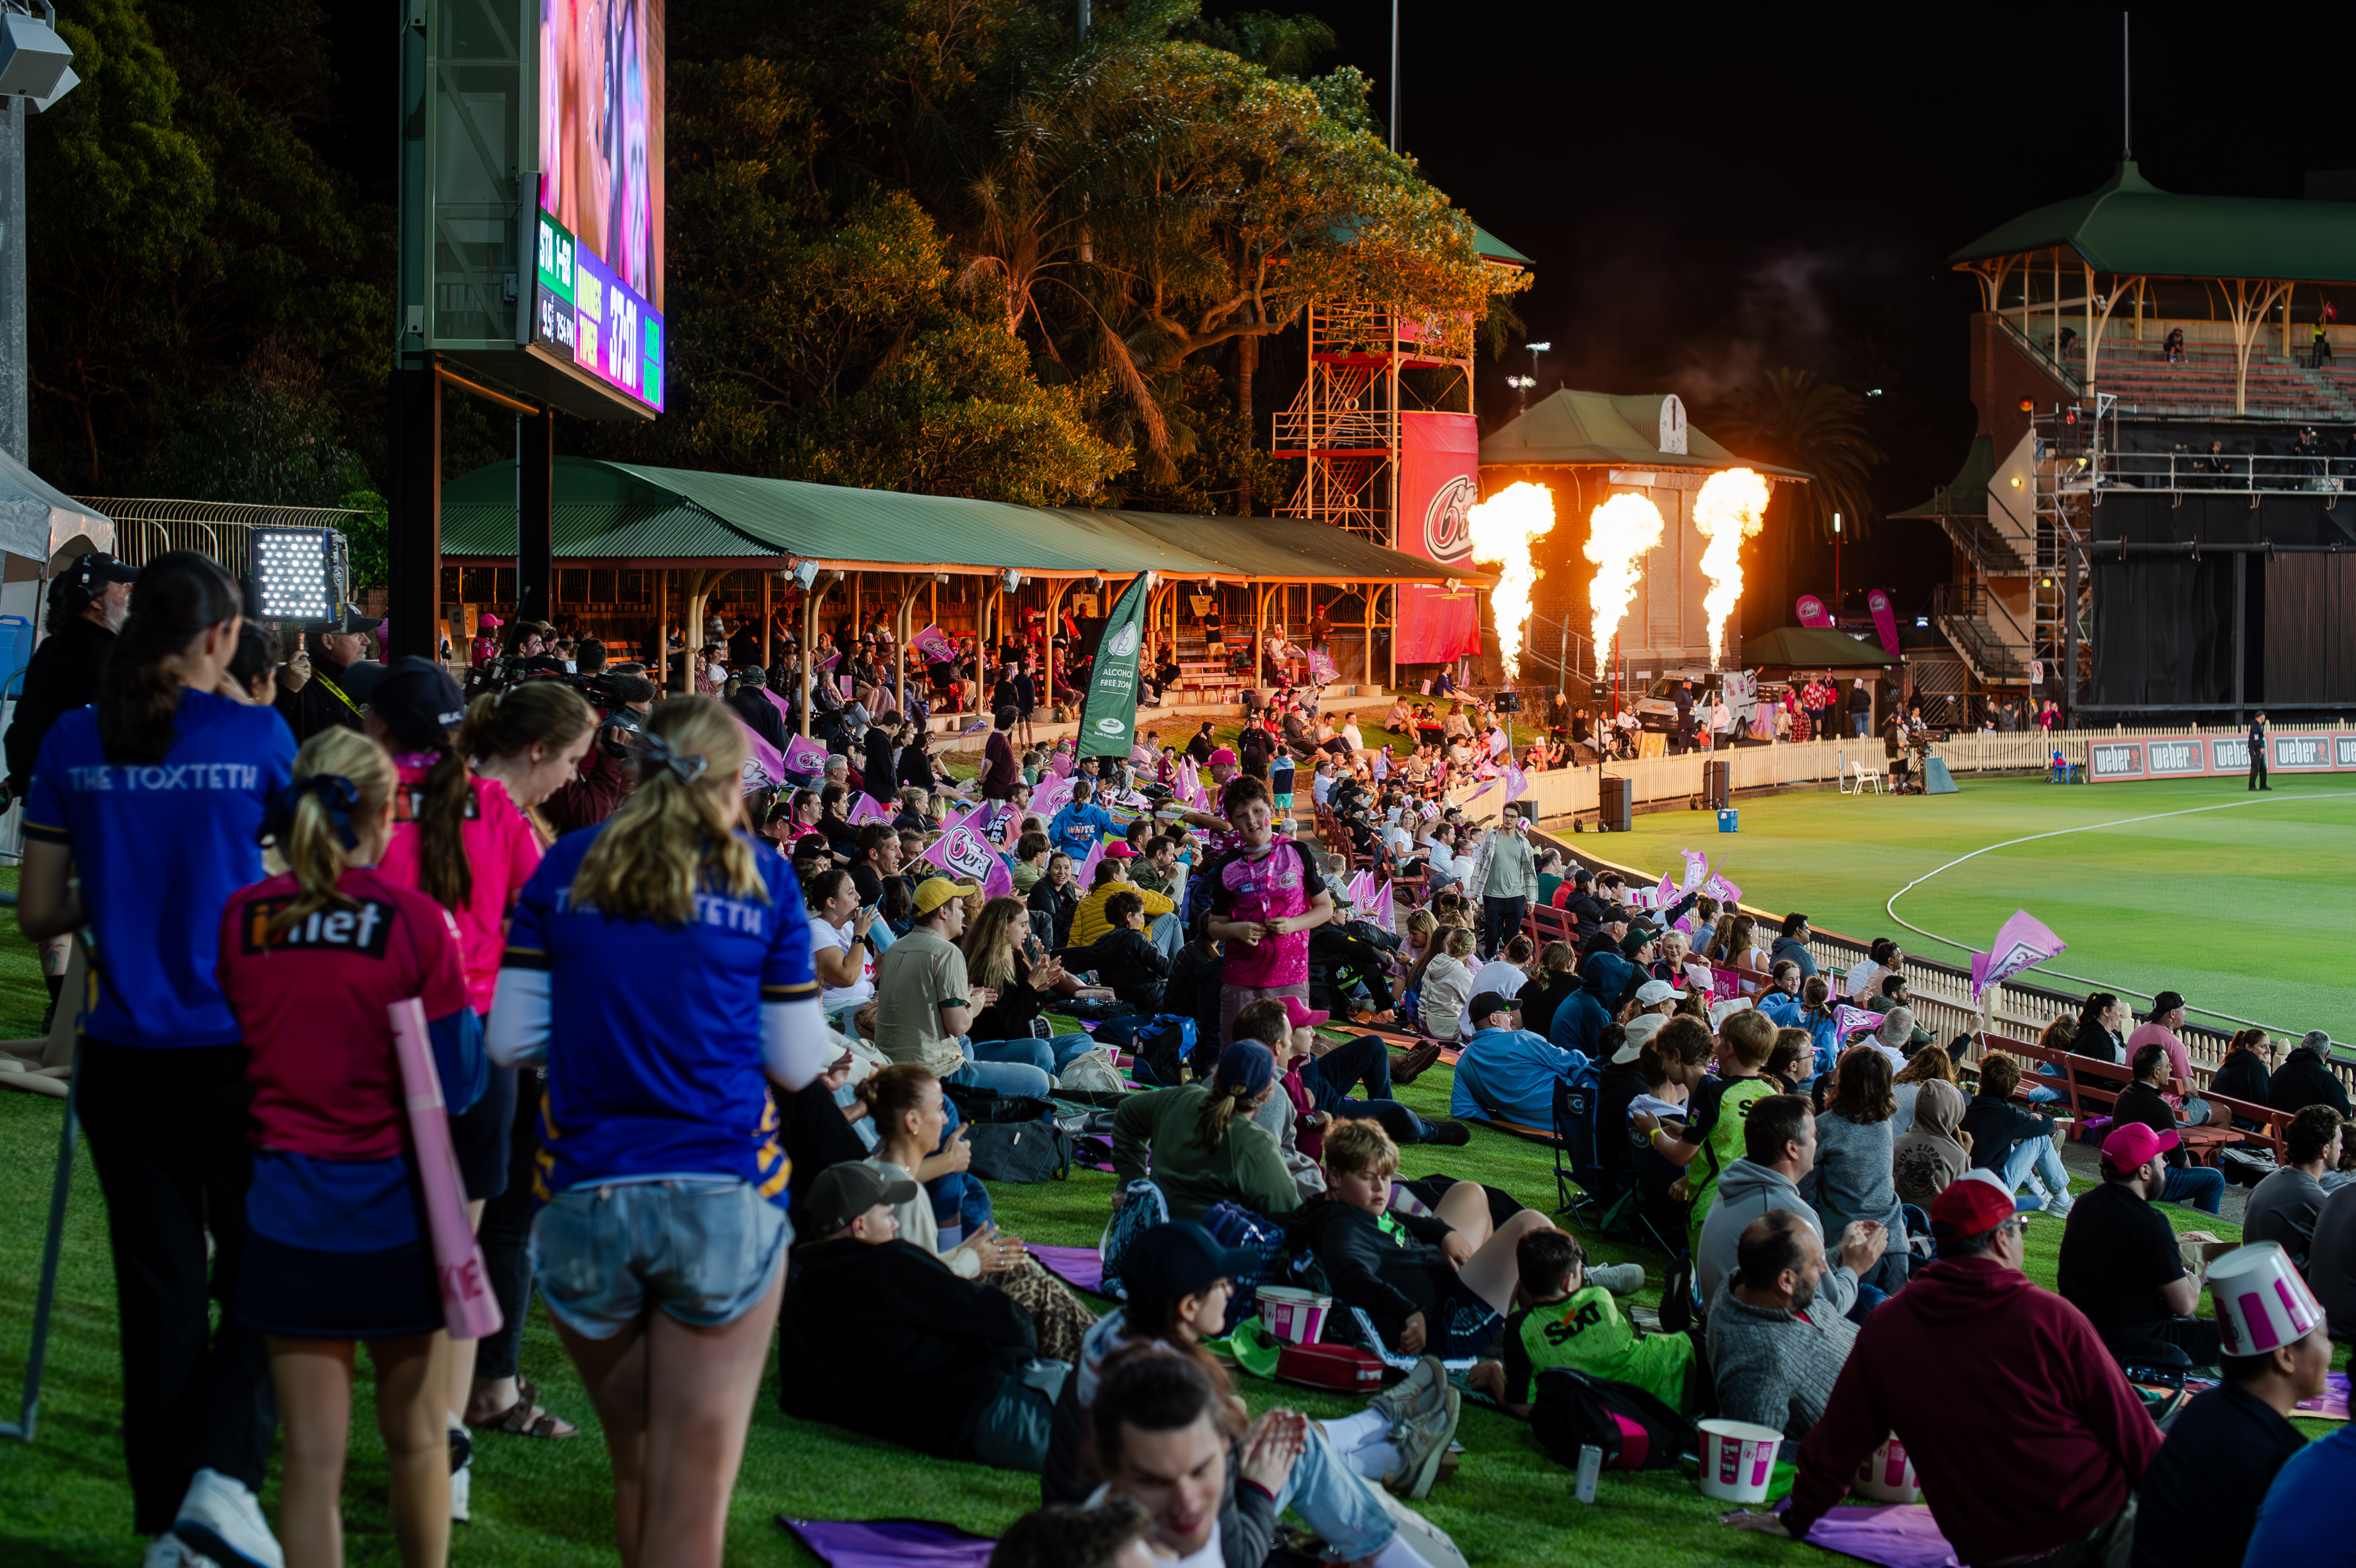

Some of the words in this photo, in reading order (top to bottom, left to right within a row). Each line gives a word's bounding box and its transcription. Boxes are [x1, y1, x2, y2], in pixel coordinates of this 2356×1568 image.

[540, 220, 553, 274] STA
[556, 234, 571, 287] 1-68
[577, 263, 602, 324] INNINGS
[542, 300, 551, 339] 9.5
[580, 313, 598, 368] TIMER
[609, 285, 637, 389] 37:01
[1117, 680, 1132, 689] ZONE
[2096, 744, 2130, 773] weber
[2152, 741, 2189, 770] weber
[2216, 740, 2251, 766] webe
[2278, 737, 2316, 764] weber
[68, 765, 112, 791] THE
[124, 764, 257, 791] TOXTETH
[1067, 825, 1095, 834] WHITE
[695, 893, 762, 935] TETH
[1897, 1146, 1913, 1167] VON
[1916, 1144, 1943, 1170] ZIPPER
